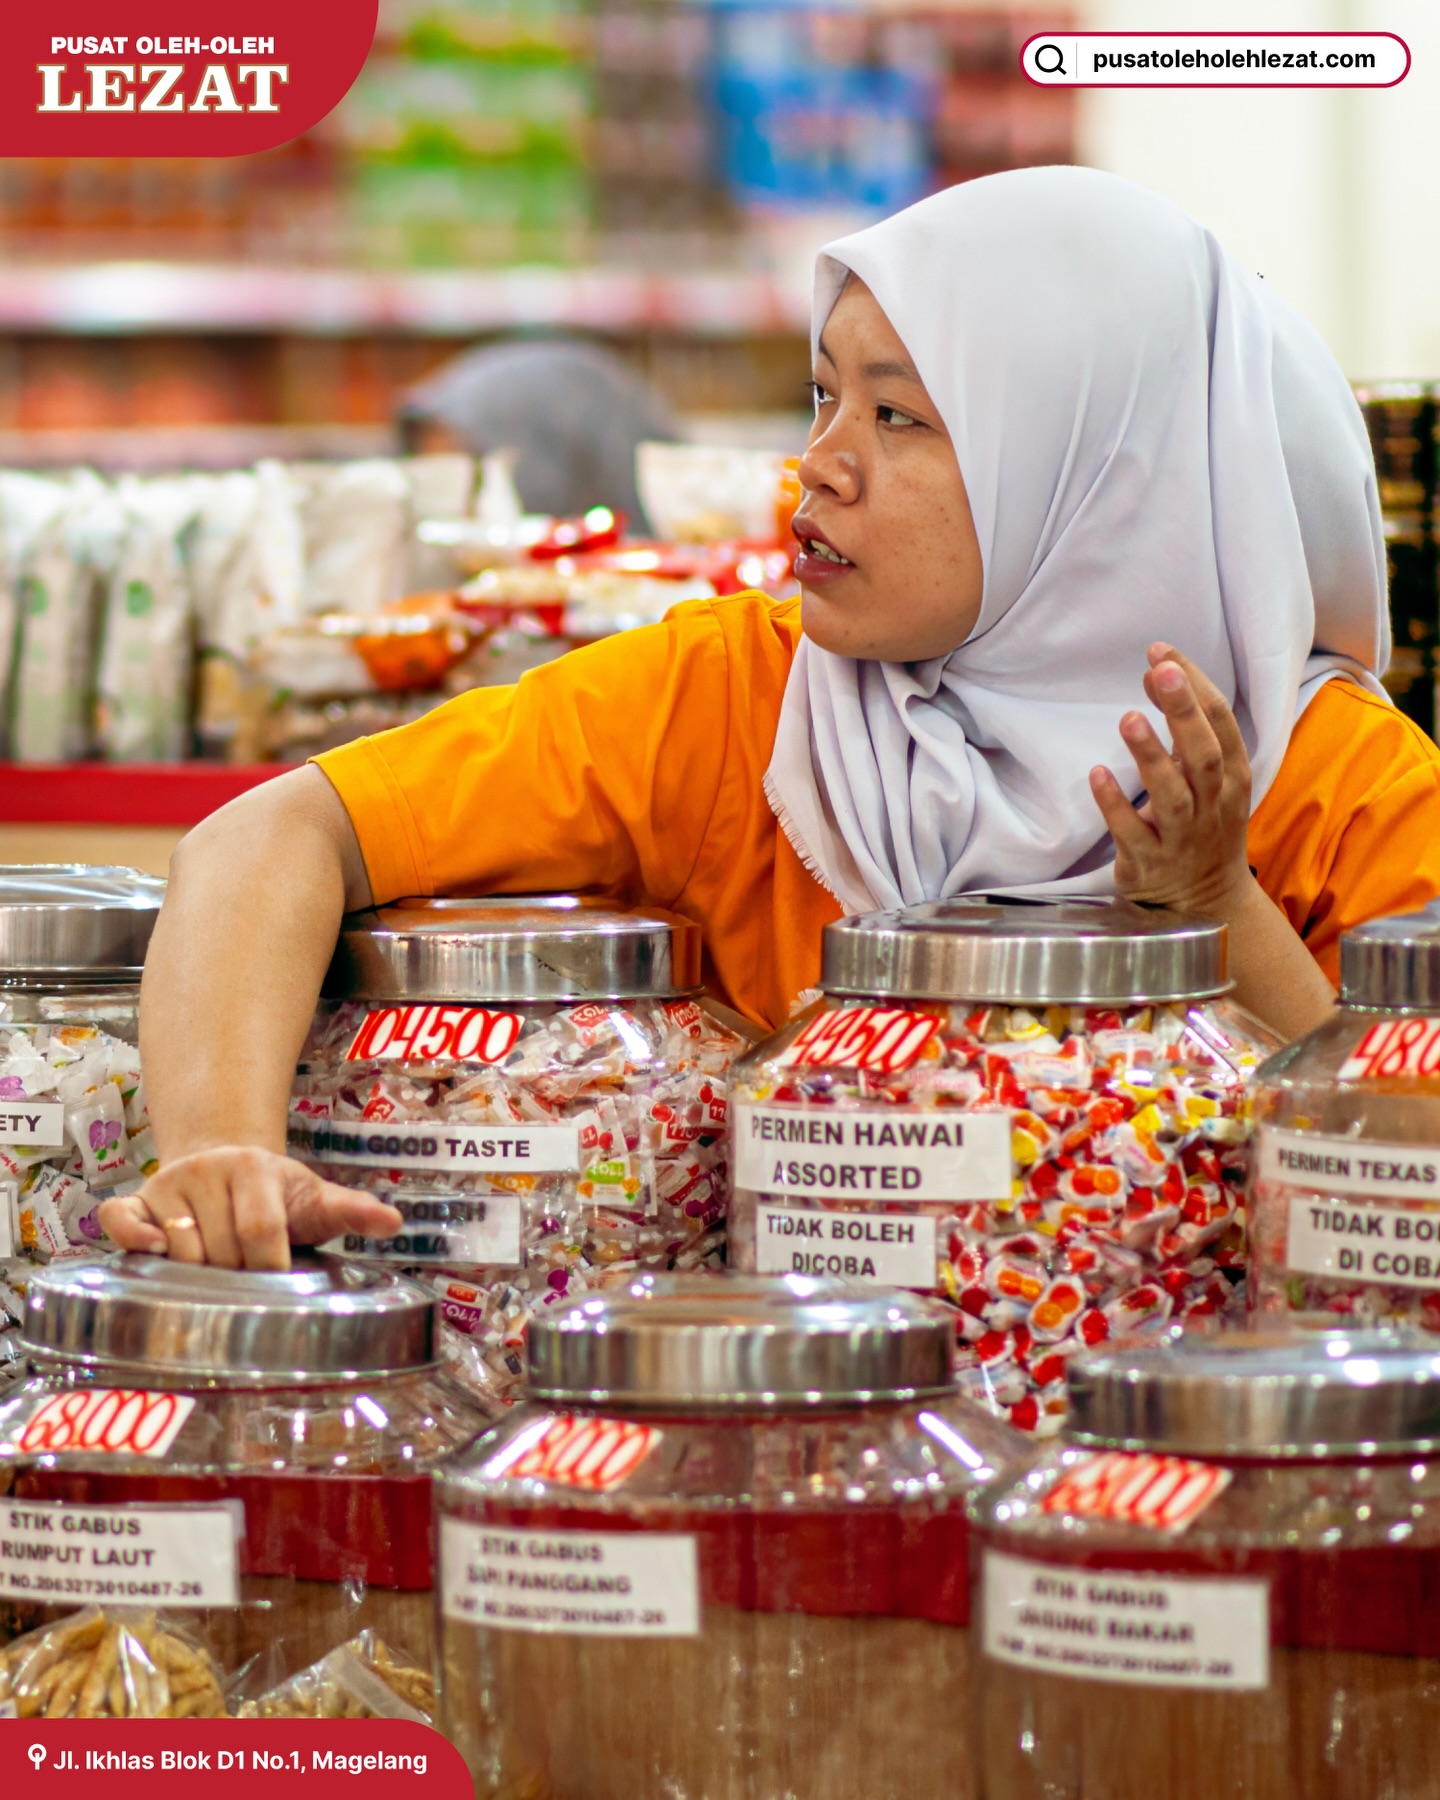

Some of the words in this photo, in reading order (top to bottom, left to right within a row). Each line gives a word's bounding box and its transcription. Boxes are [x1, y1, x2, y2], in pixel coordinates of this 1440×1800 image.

[752, 1115, 843, 1145] PERMEN
[855, 1123, 963, 1147] HAWAI
[367, 1135, 438, 1157] GOOD
[445, 1139, 530, 1158] TASTE
[773, 1161, 922, 1190] ASSORTED
[1279, 1148, 1350, 1176] PERMEN
[1358, 1160, 1436, 1183] TEXAS
[767, 1214, 823, 1238] TIDAK
[832, 1221, 914, 1244] BOLEH
[1310, 1208, 1384, 1237] TIDAK
[1339, 1249, 1361, 1272] DI
[10, 1511, 53, 1532] STIK
[61, 1516, 141, 1535] GABUS
[1, 1540, 83, 1565] RUMPUT
[92, 1548, 155, 1567] LAUT
